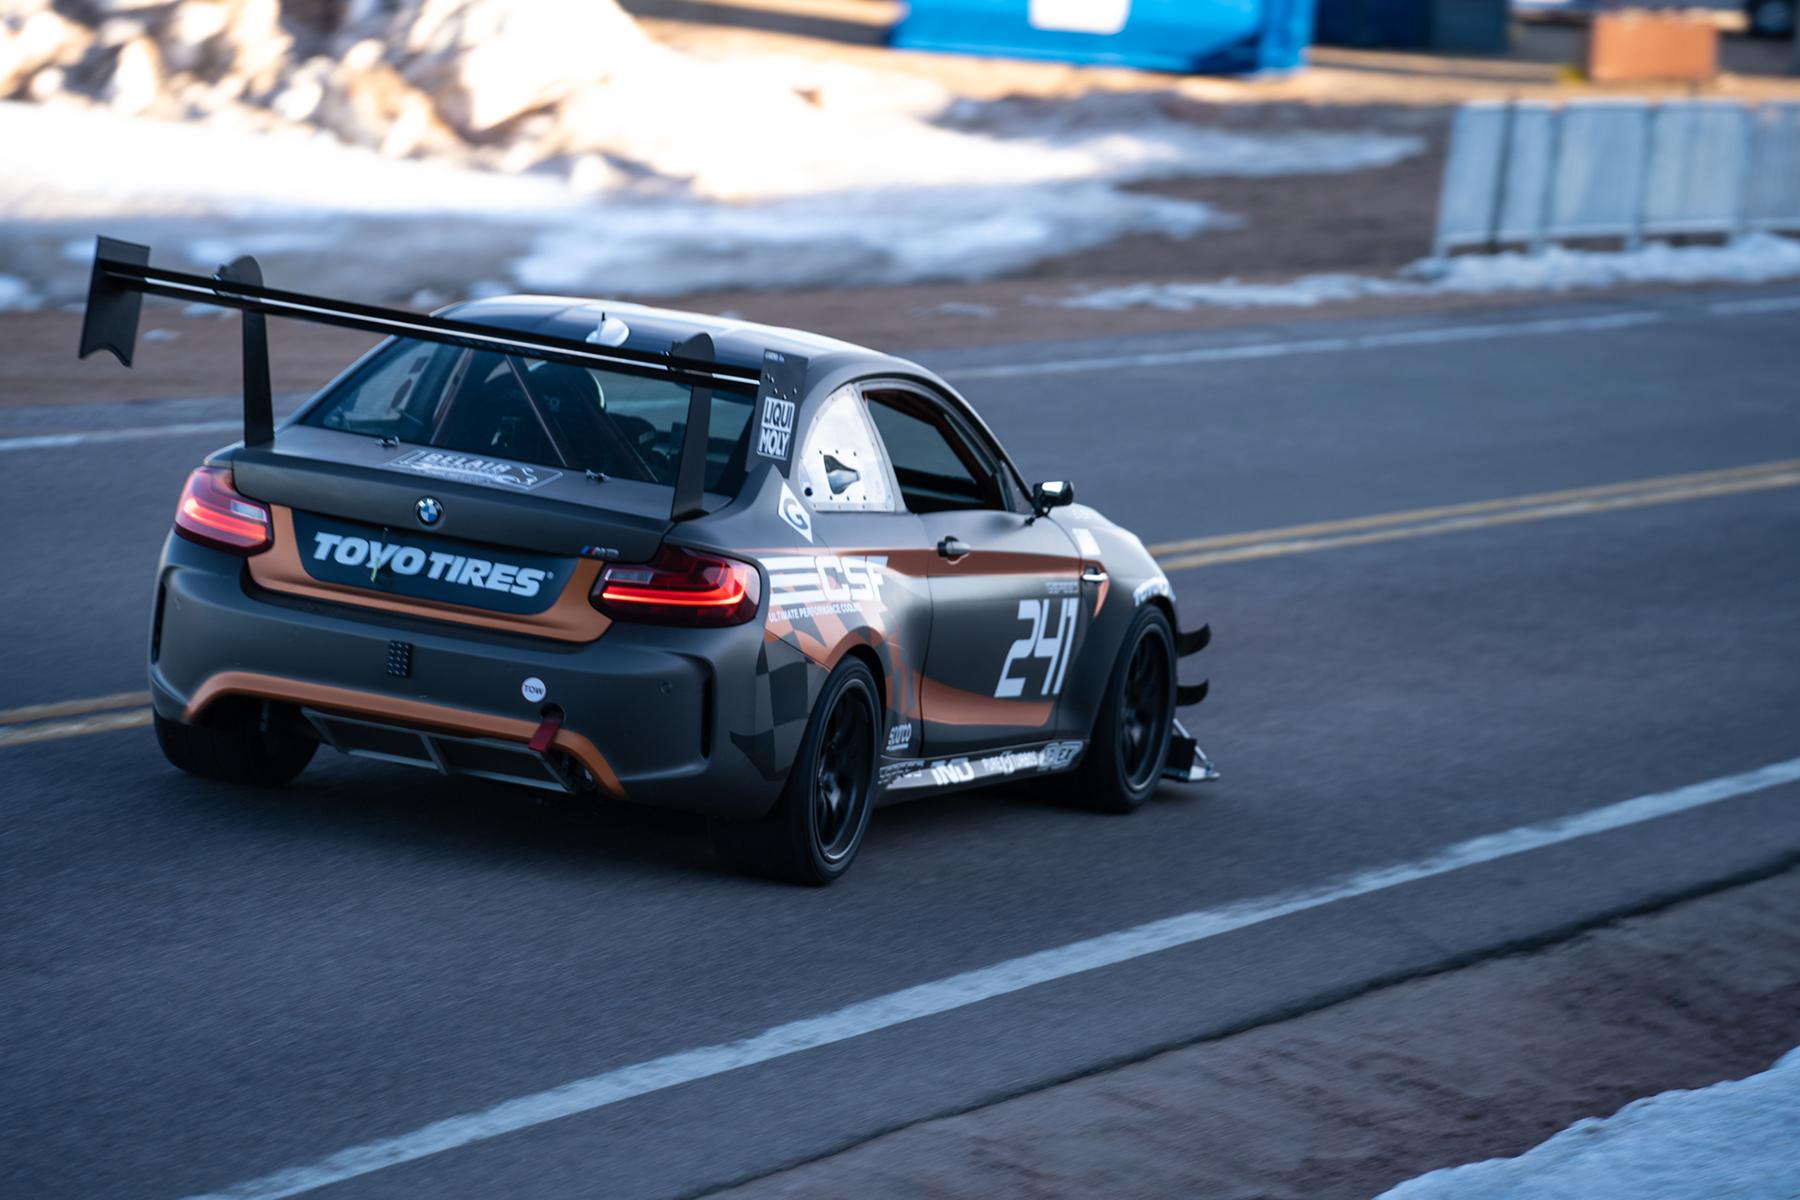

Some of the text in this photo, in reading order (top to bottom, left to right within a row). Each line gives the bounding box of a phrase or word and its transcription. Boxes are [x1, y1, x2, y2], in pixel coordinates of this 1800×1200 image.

[763, 400, 793, 429] LIQUI
[760, 428, 790, 457] MOLY
[313, 532, 545, 597] TOYO TIRES
[994, 598, 1079, 698] 241
[524, 684, 545, 696] TOW
